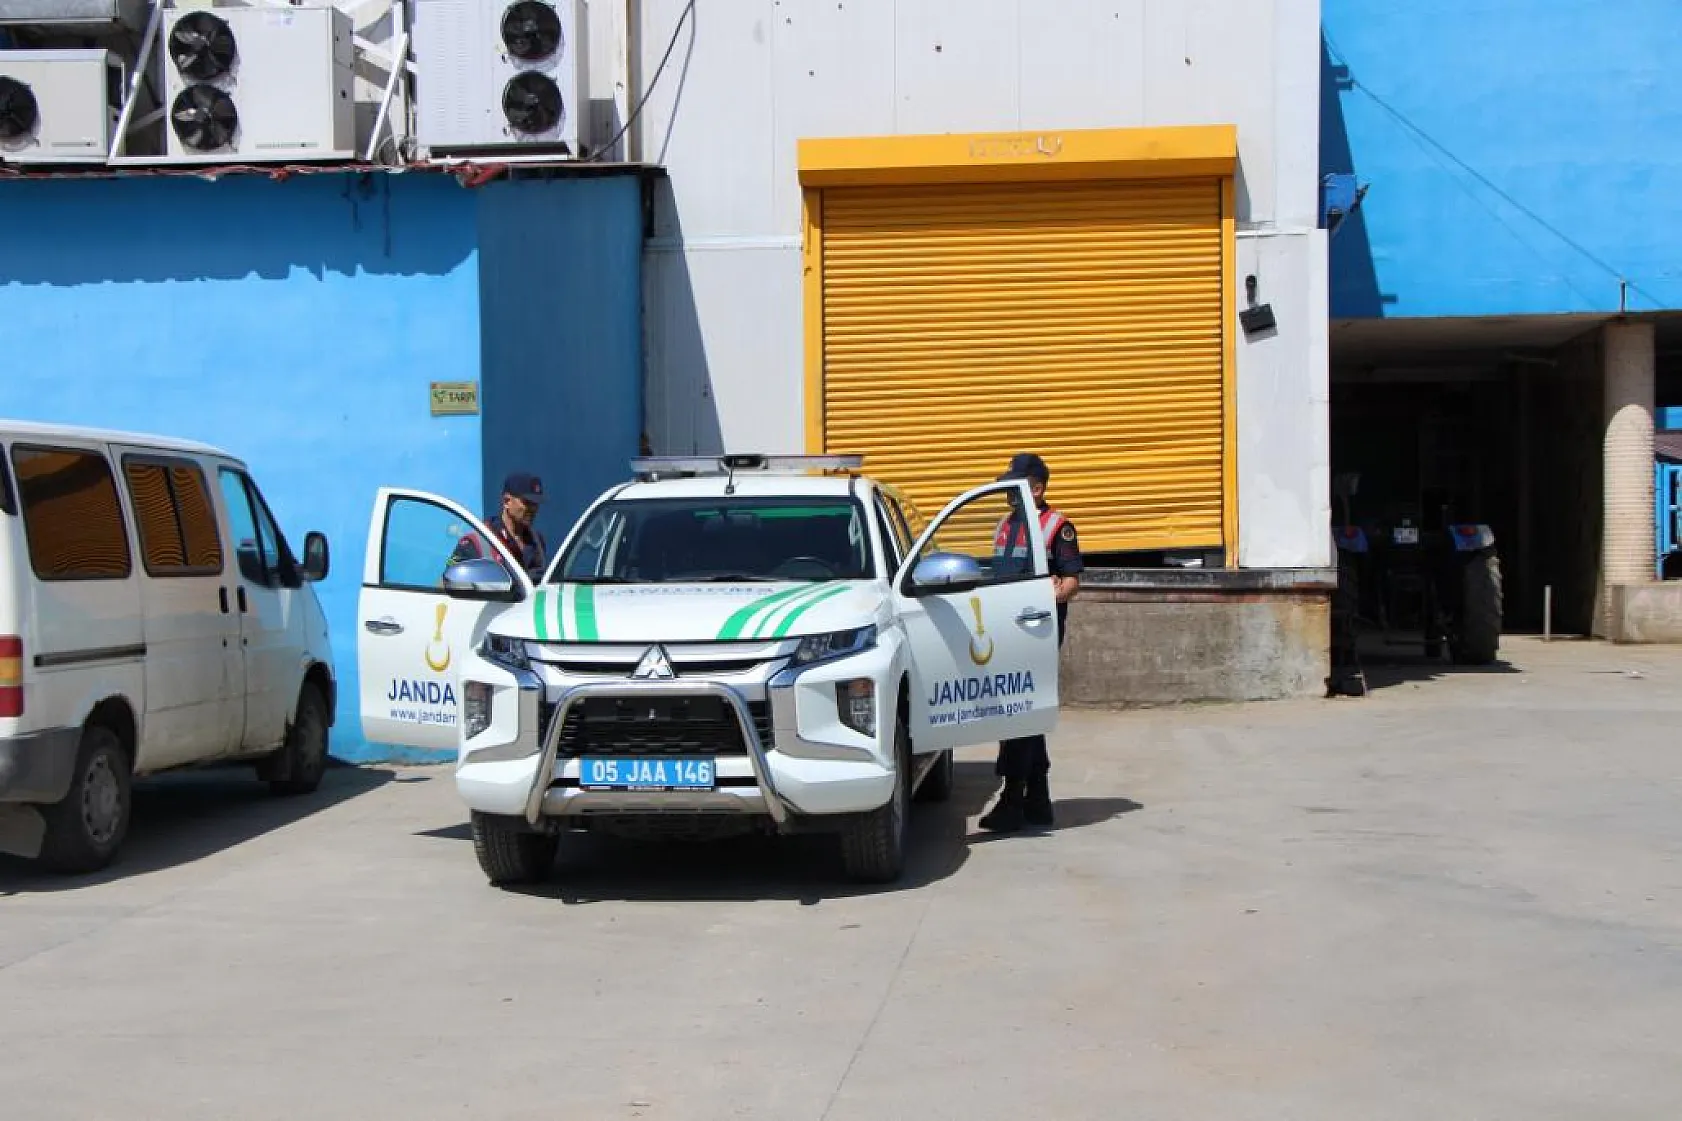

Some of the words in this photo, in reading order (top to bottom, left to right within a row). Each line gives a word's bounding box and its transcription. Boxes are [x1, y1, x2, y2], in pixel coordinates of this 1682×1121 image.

[388, 677, 457, 706] JANDA
[928, 669, 1035, 707] JANDARMA
[592, 760, 619, 782] 05
[626, 760, 668, 782] JAA
[674, 760, 710, 783] 146
